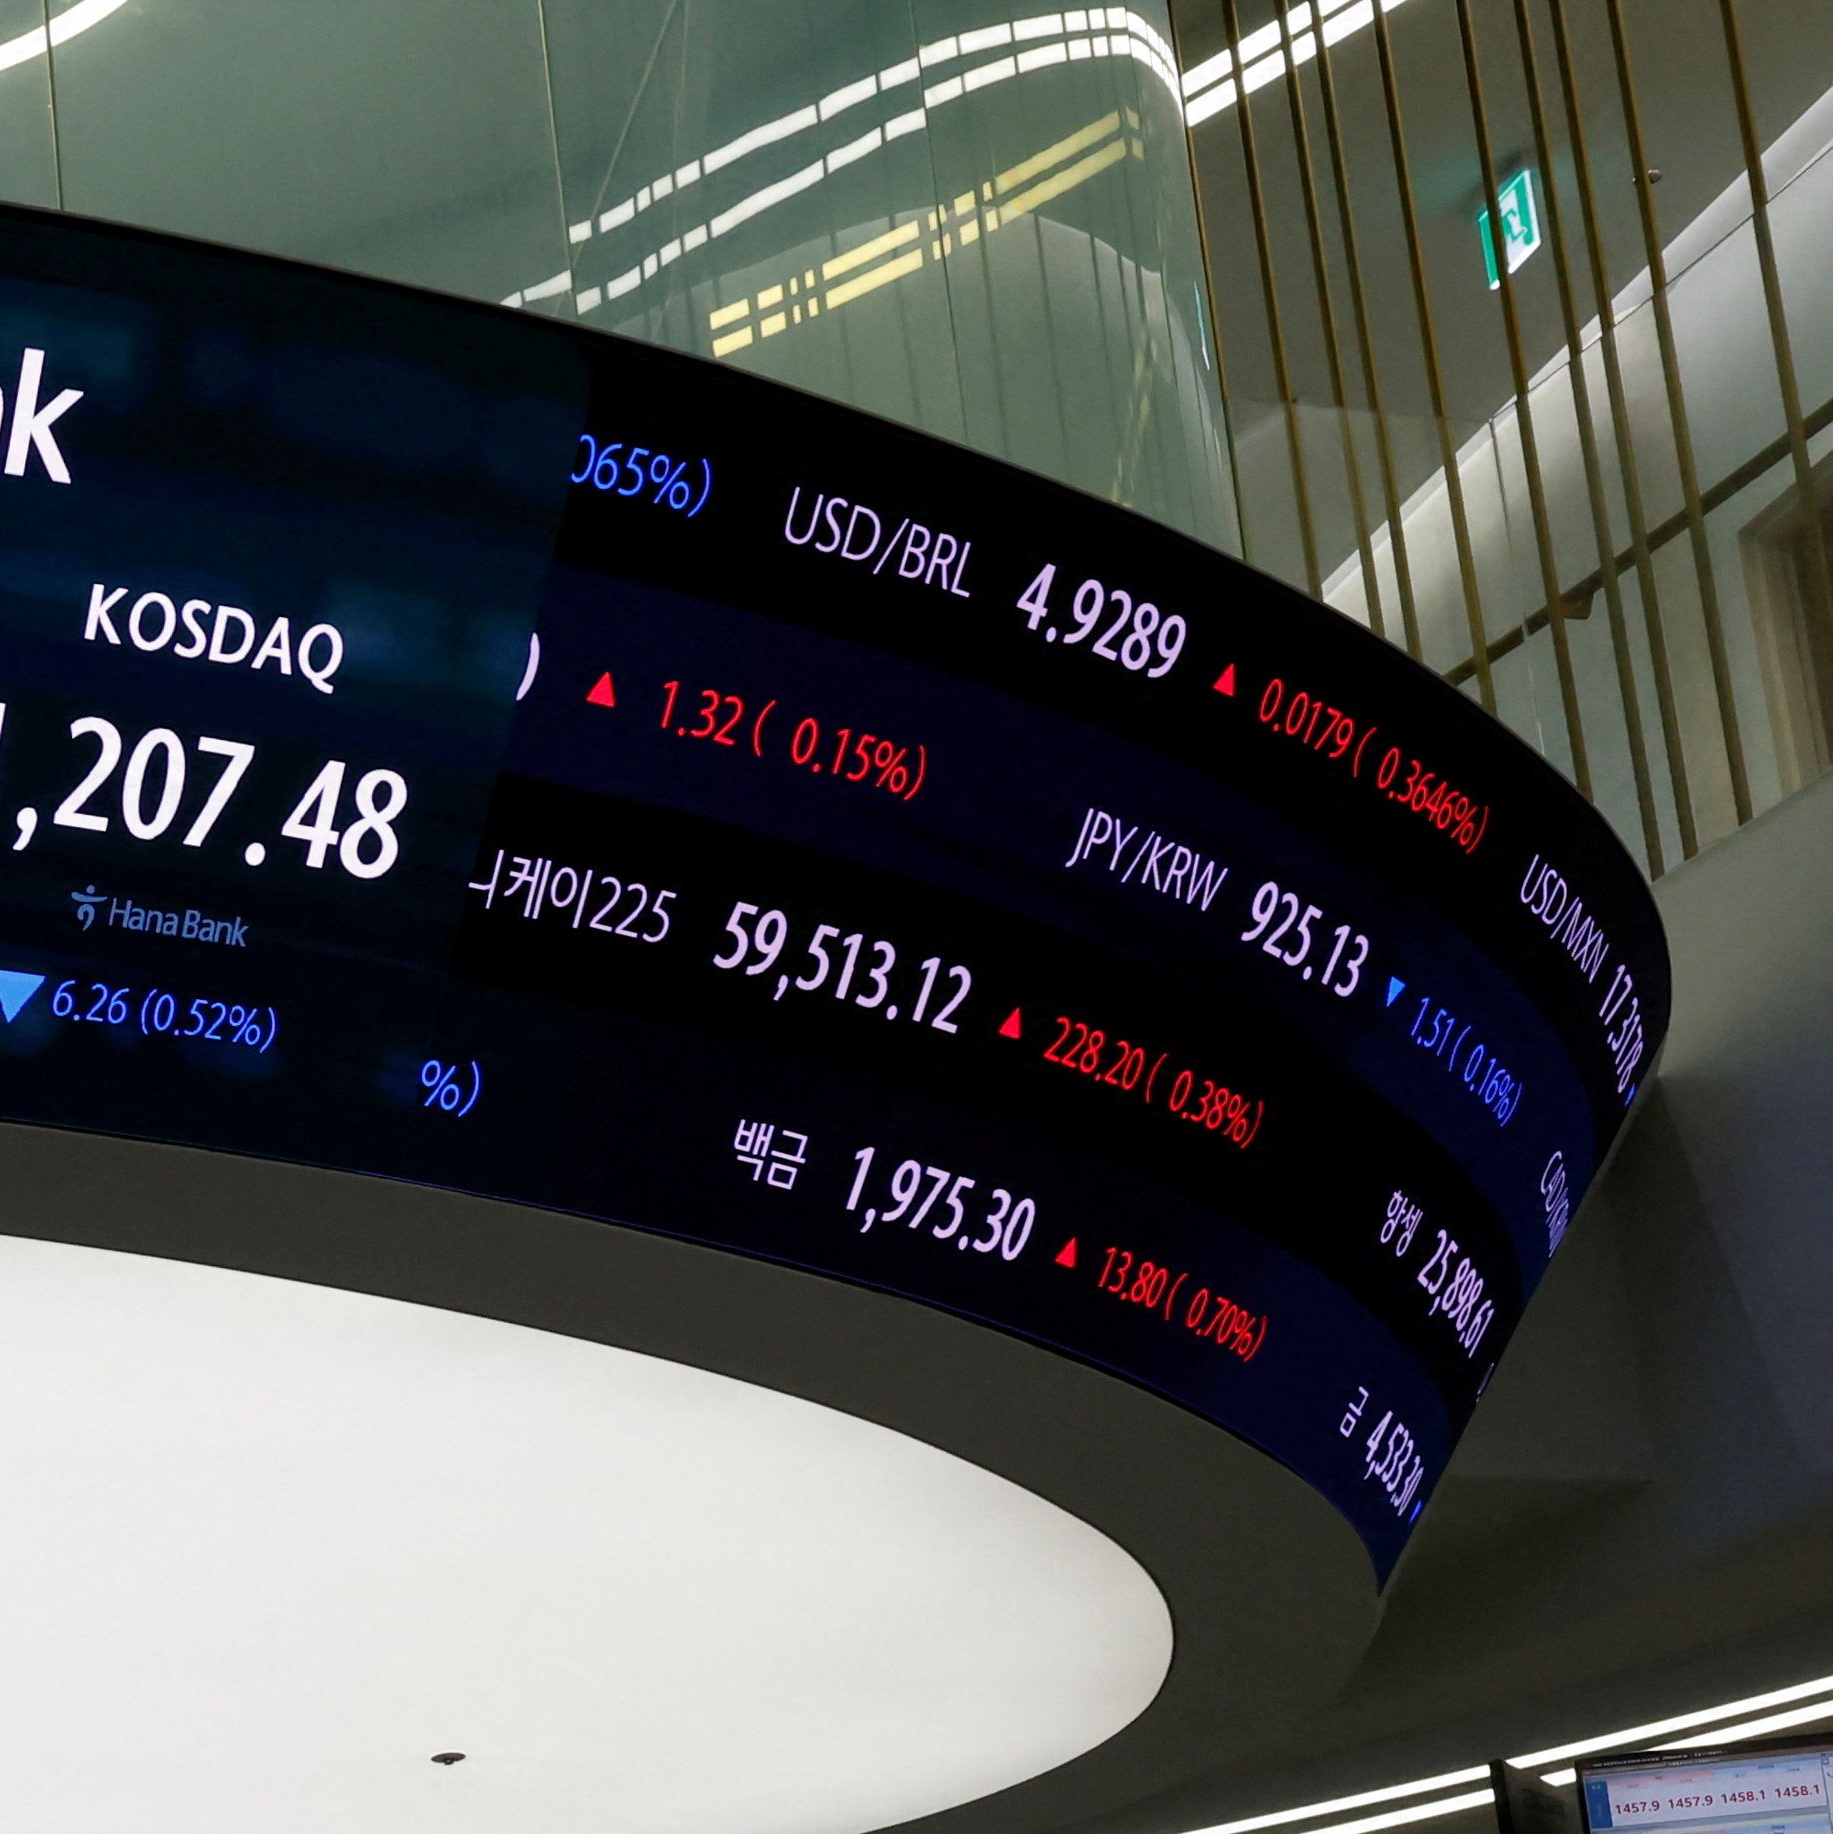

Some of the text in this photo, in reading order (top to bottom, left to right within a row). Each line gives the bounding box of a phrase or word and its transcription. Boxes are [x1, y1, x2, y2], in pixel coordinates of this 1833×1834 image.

[83, 583, 344, 695] KOSDAQ
[784, 486, 971, 598] USD/BRL
[1016, 563, 1187, 679] 4.9289
[1259, 678, 1354, 758] 0.0179
[1520, 854, 1610, 984] USD/MXN
[661, 680, 744, 746] 1.32
[791, 717, 926, 801] 0.15%)
[1064, 807, 1229, 912] JPY/KRW
[1240, 881, 1369, 997] 925.13
[108, 897, 250, 948] Hana Bank
[712, 901, 972, 1034] 59,513.12
[1043, 1016, 1145, 1091] 228.20
[50, 979, 278, 1054] 6.26 (0.52%)
[733, 1118, 809, 1190] 백금
[845, 1146, 1036, 1261] 1,975.30
[1097, 1246, 1168, 1308] 13.80
[1615, 1784, 1820, 1815] 1457.9 1457.9 1458.1 1458.1
